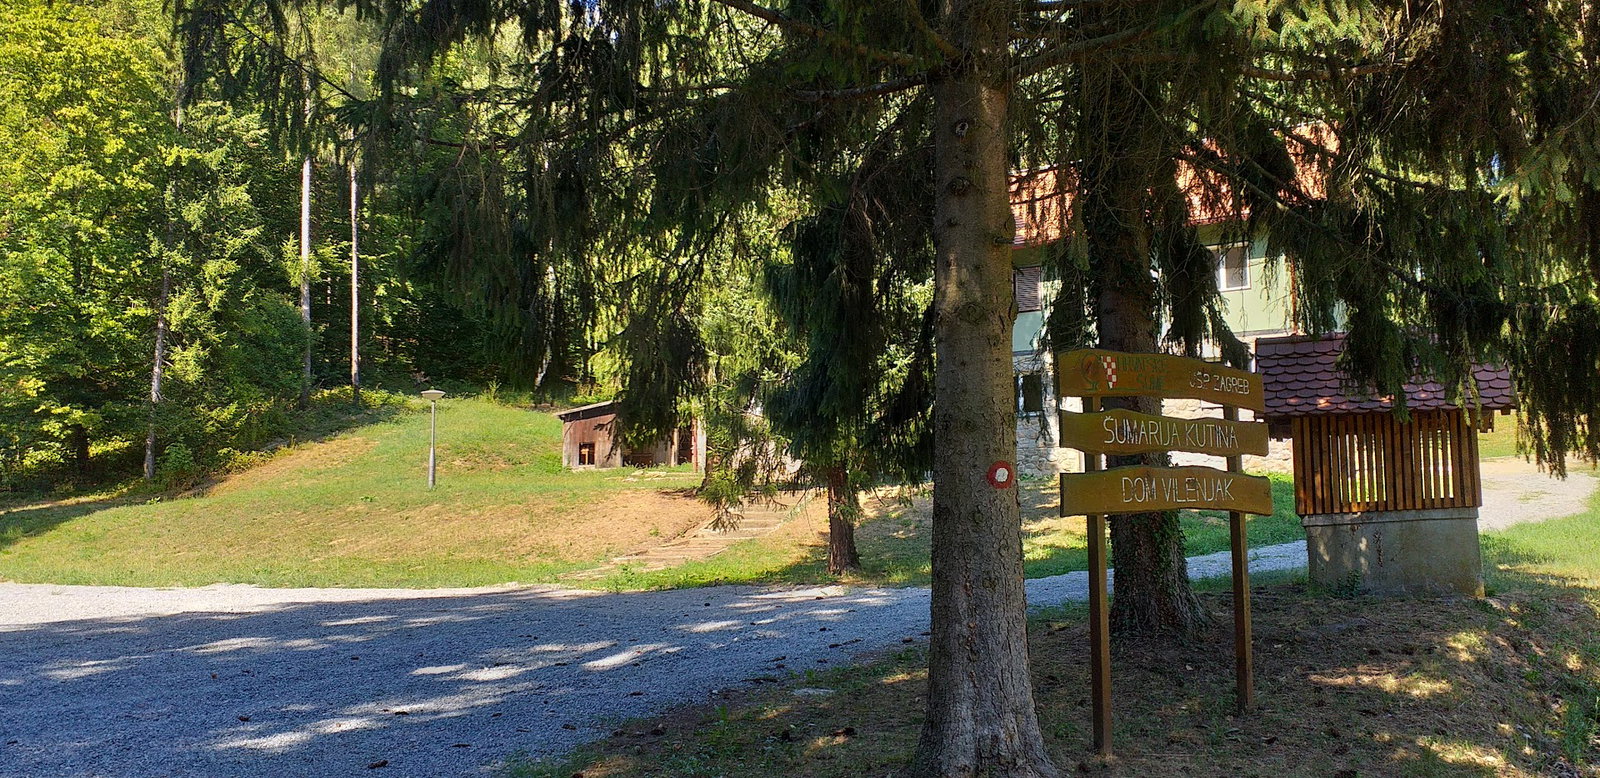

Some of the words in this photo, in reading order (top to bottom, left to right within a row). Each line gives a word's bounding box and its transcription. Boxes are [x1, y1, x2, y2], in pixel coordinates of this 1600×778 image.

[1213, 374, 1250, 395] ZAGREB
[1103, 415, 1181, 447] ŠUMARIJA
[1185, 422, 1239, 449] KUTINA
[1121, 476, 1157, 503] DOM
[1161, 477, 1235, 502] VILENJAK
